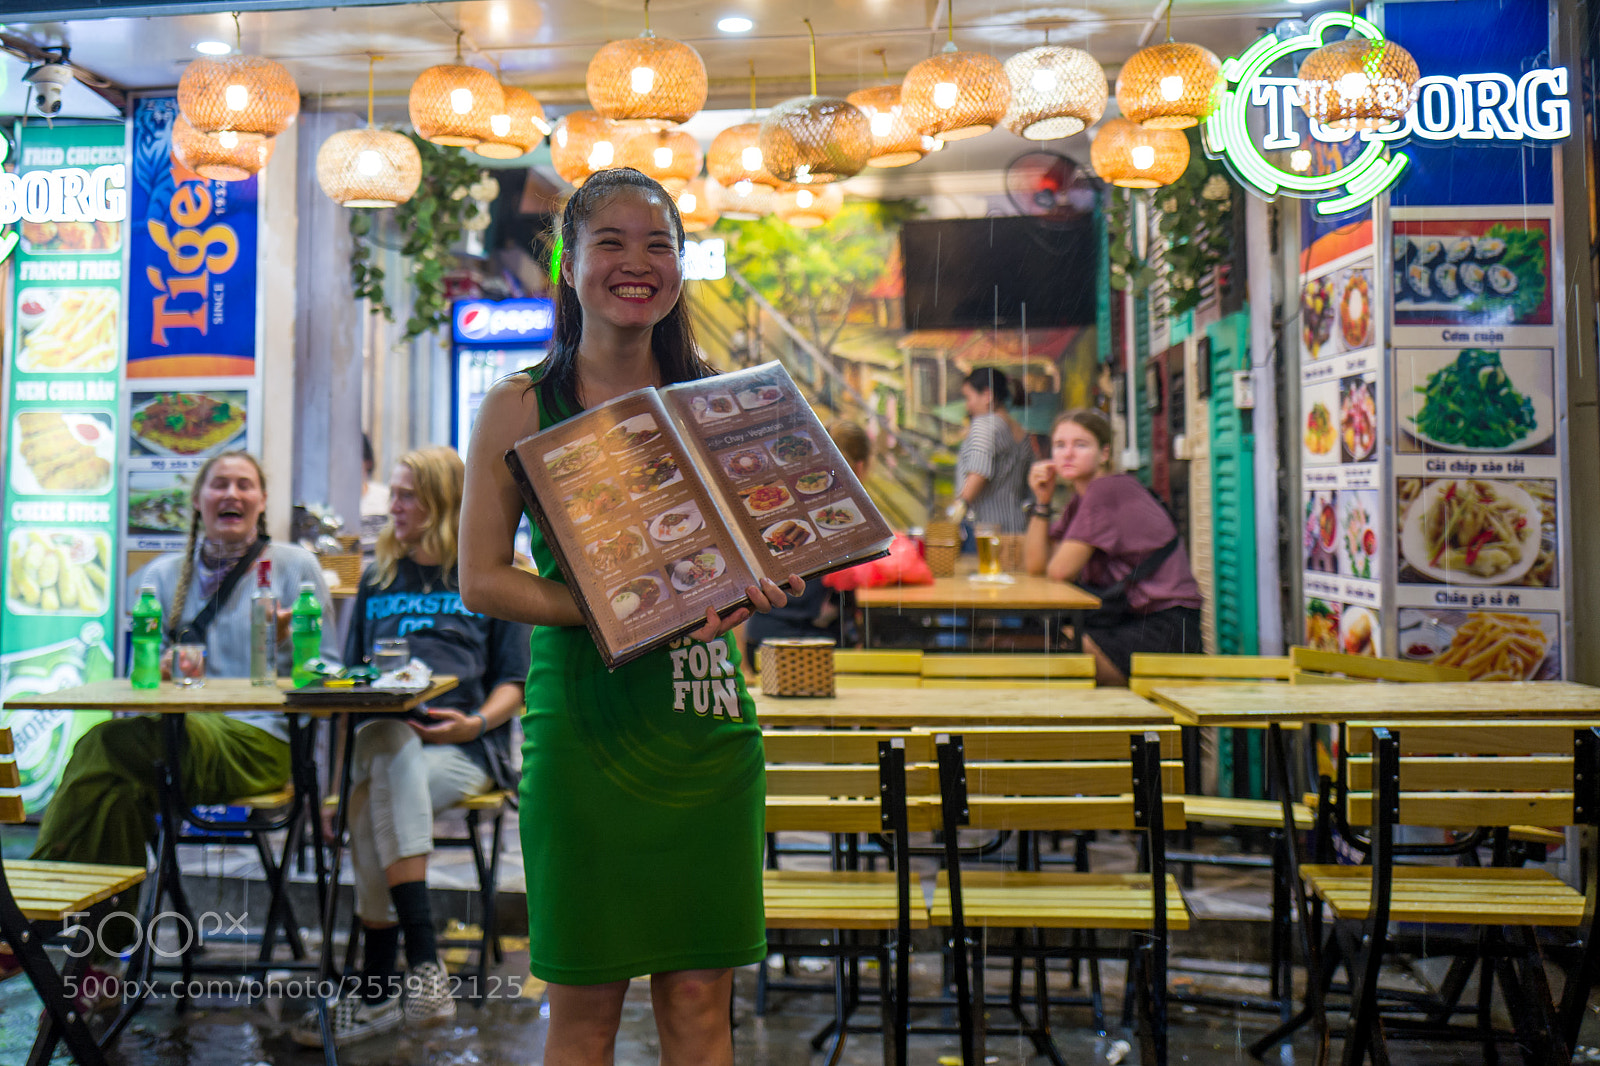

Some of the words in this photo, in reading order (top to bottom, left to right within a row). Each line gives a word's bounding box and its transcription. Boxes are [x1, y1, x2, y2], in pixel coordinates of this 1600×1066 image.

[23, 147, 64, 165] FRIED
[215, 180, 227, 216] 1932
[147, 151, 239, 347] Tiger
[20, 261, 77, 280] FRENCH
[79, 260, 121, 279] FRIES
[214, 284, 225, 324] SINCE
[11, 501, 65, 521] CHEESE
[669, 638, 736, 679] FOR
[672, 679, 743, 723] FUN
